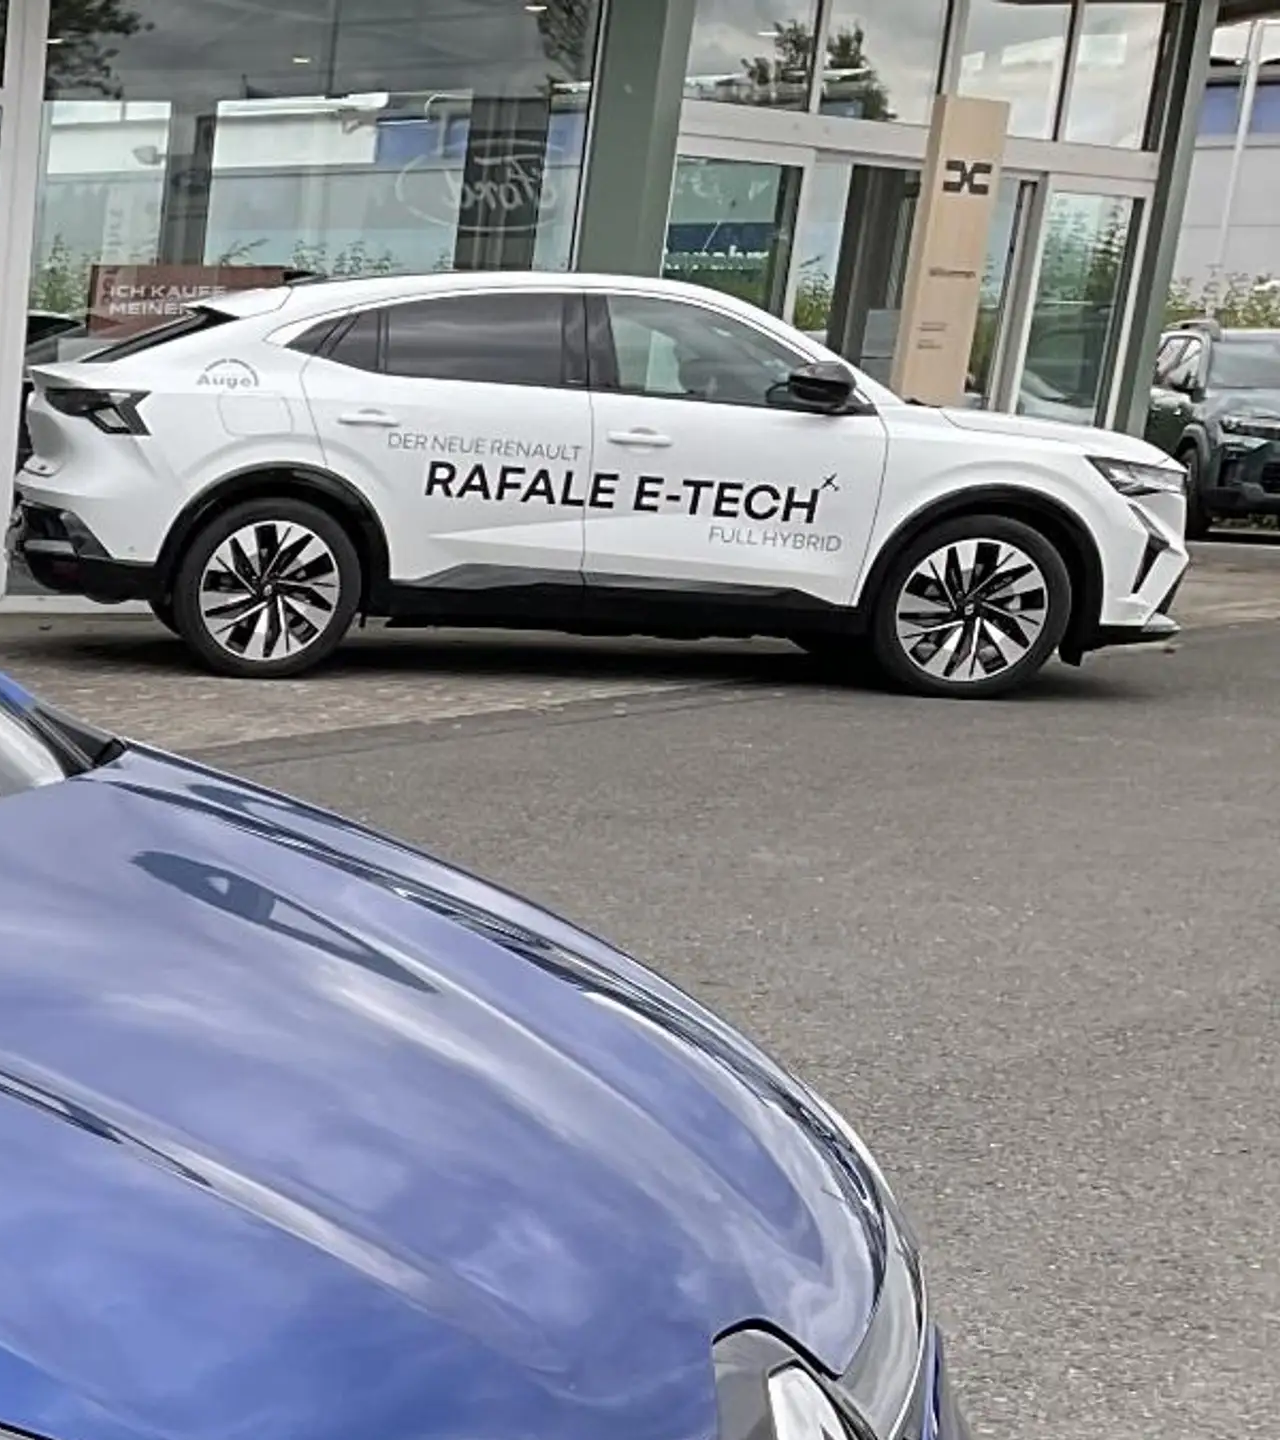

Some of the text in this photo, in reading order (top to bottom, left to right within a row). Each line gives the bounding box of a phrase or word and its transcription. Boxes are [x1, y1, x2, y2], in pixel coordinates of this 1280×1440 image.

[109, 285, 145, 297] ICH
[388, 432, 582, 461] DER NEUE RENAULT
[425, 461, 819, 523] RAFALE E-TECH
[709, 526, 842, 552] FULL HYBRID
